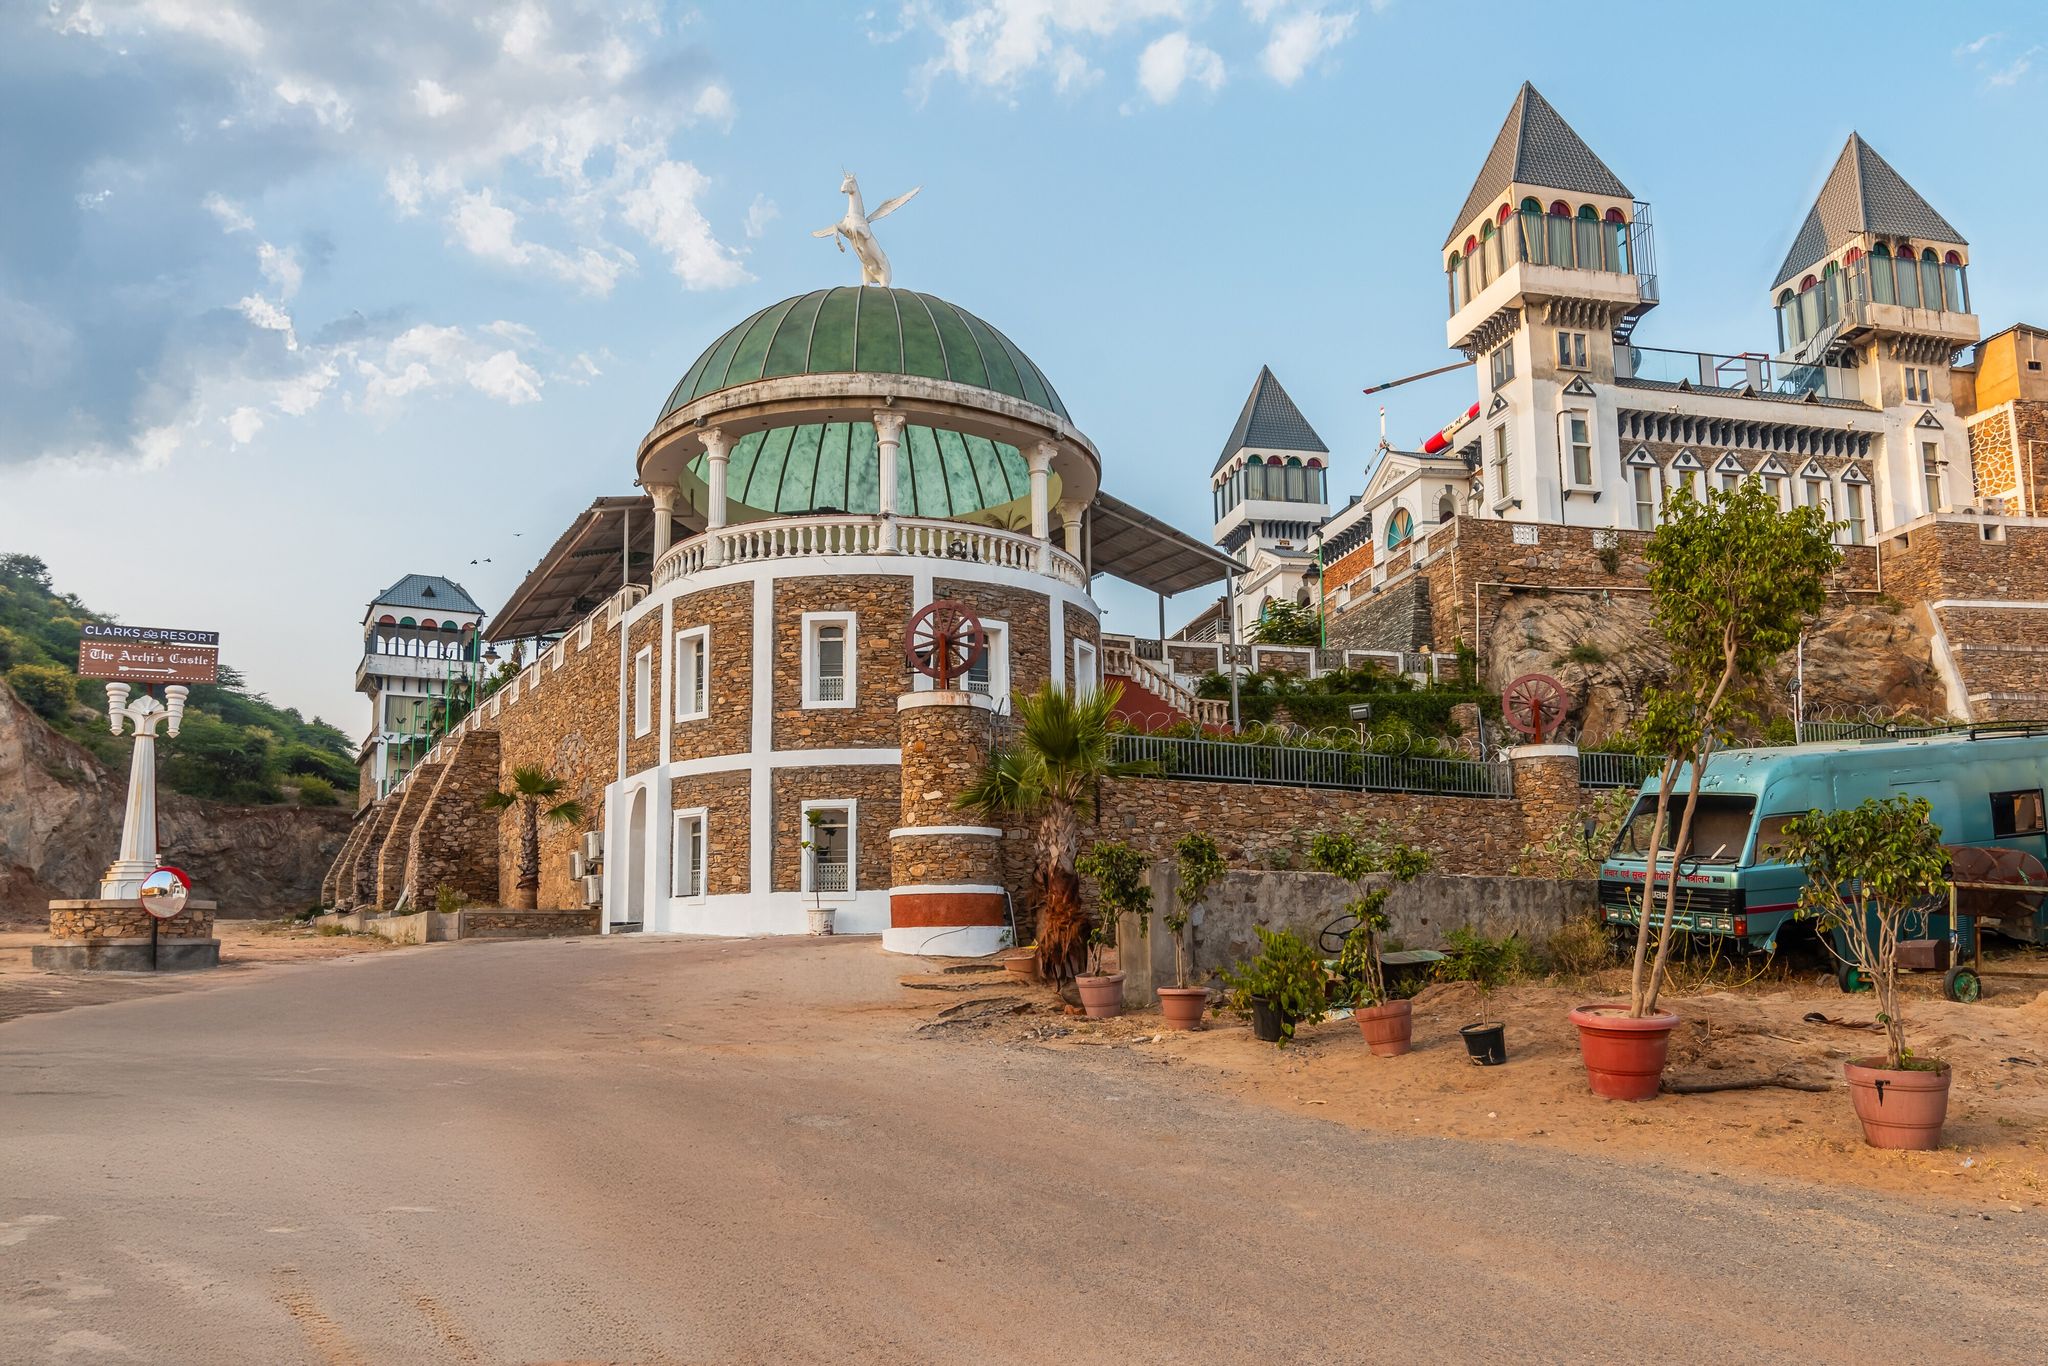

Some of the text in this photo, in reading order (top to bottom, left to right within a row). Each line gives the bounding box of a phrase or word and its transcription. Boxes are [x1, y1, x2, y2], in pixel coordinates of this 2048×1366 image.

[85, 625, 215, 643] CLARKS RESORT
[89, 648, 209, 666] The Archi's Castle
